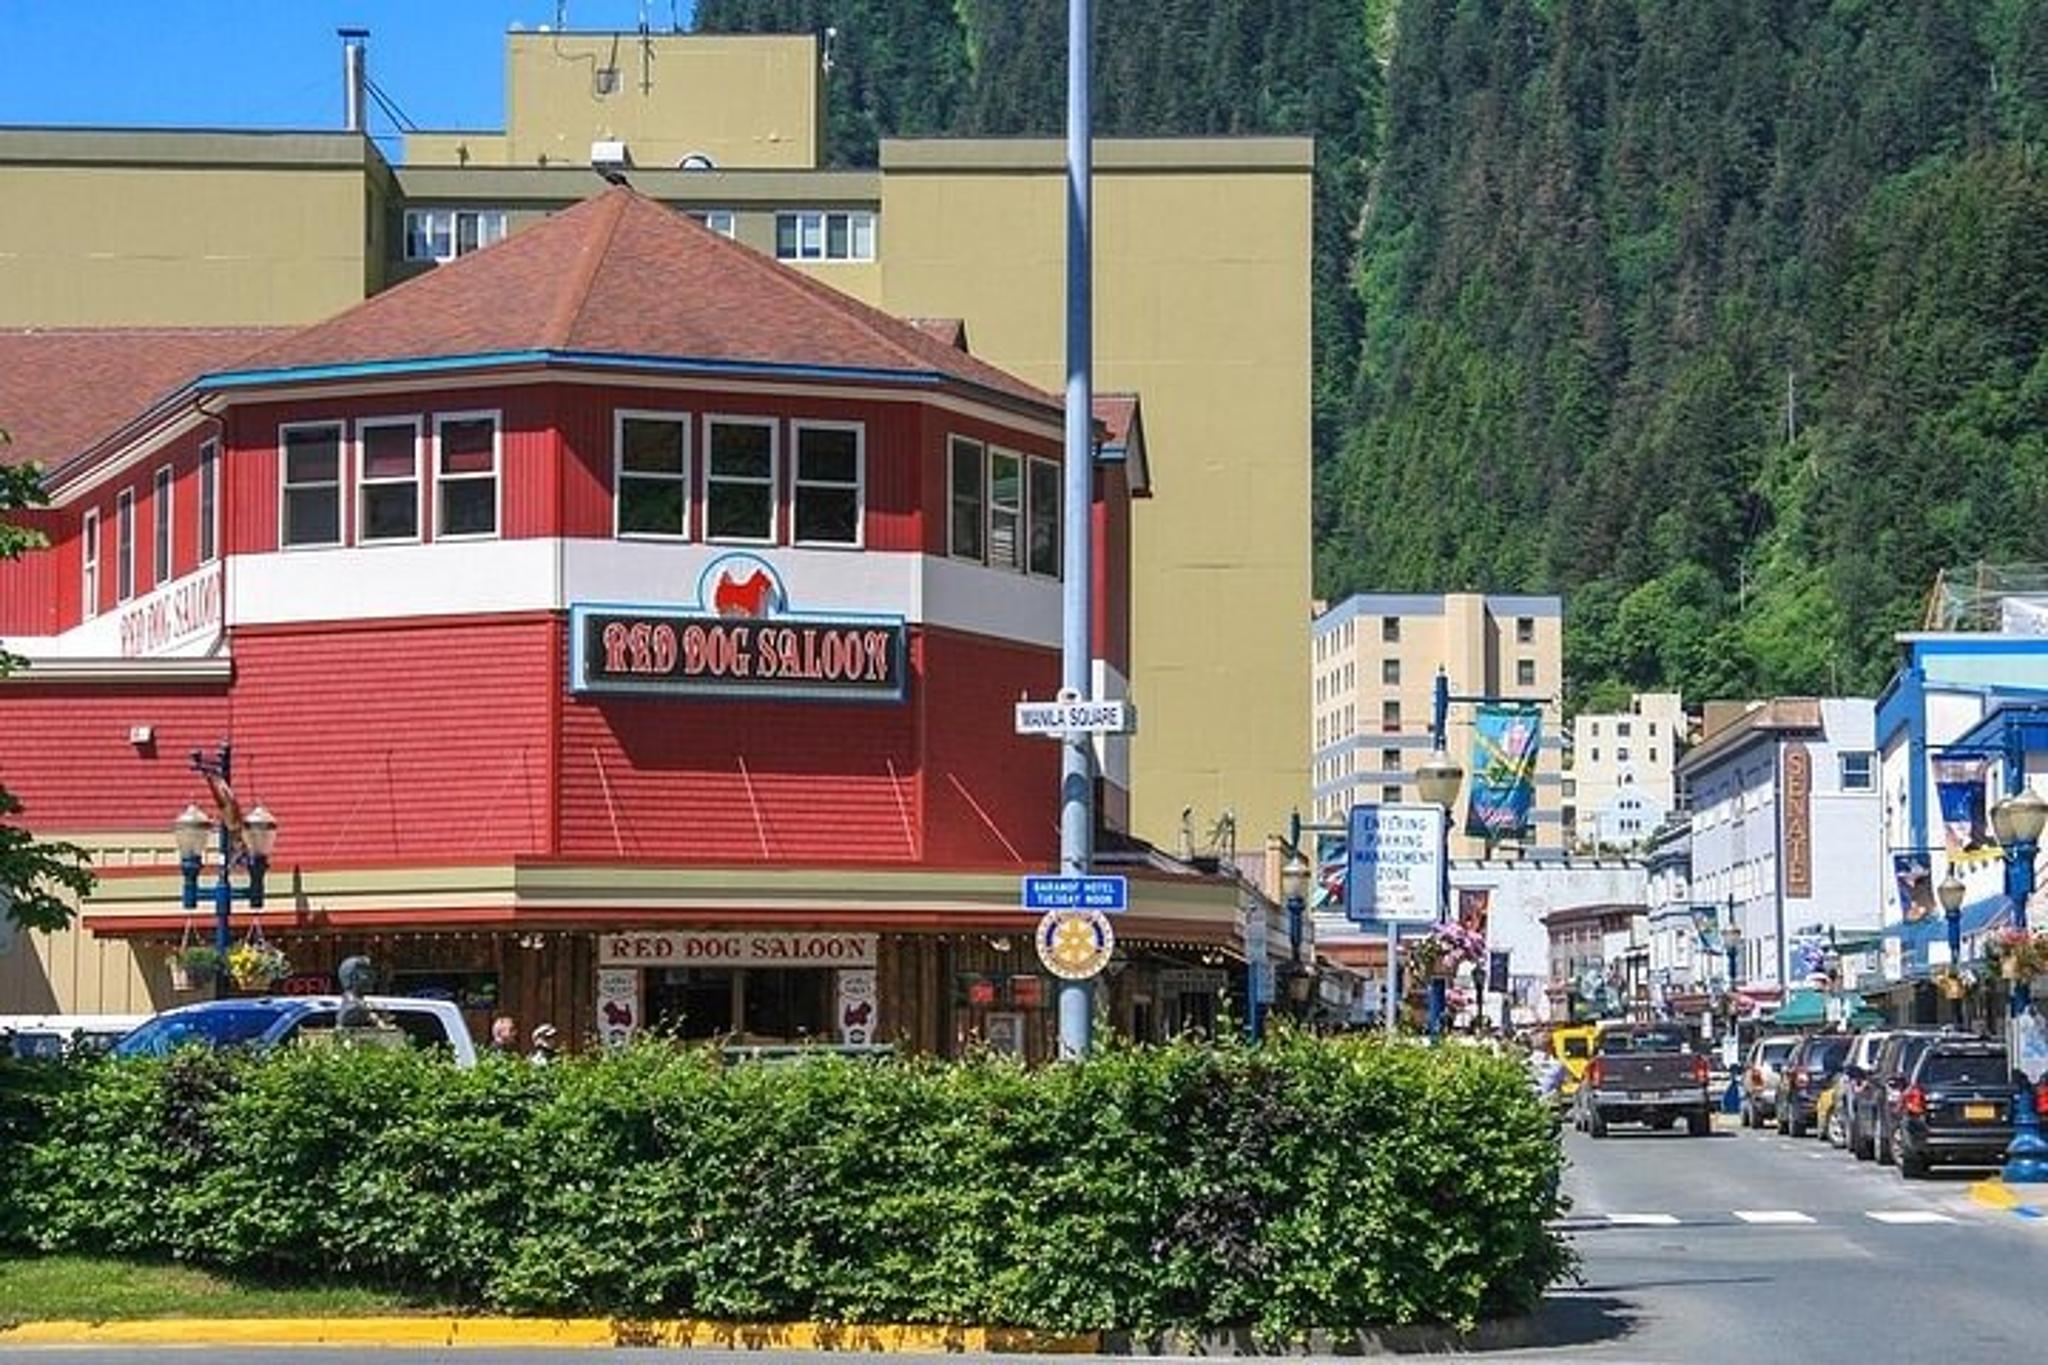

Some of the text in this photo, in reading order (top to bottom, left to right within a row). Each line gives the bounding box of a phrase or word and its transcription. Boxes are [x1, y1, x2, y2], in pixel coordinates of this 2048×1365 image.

[121, 607, 145, 657] RED
[147, 595, 171, 651] DOG
[603, 622, 888, 680] RED DOG SALOON
[1021, 706, 1117, 728] MANILA SQUARE
[1363, 816, 1428, 832] ENTERING
[1787, 752, 1807, 885] SENATE
[1364, 832, 1424, 848] PARKING
[1354, 849, 1435, 864] MANAGEMENT
[1376, 866, 1411, 882] ZONE
[1083, 881, 1116, 894] HOTEL
[1085, 894, 1114, 906] NOON
[611, 936, 866, 959] RED DOG SALOON
[283, 976, 331, 995] OPEN
